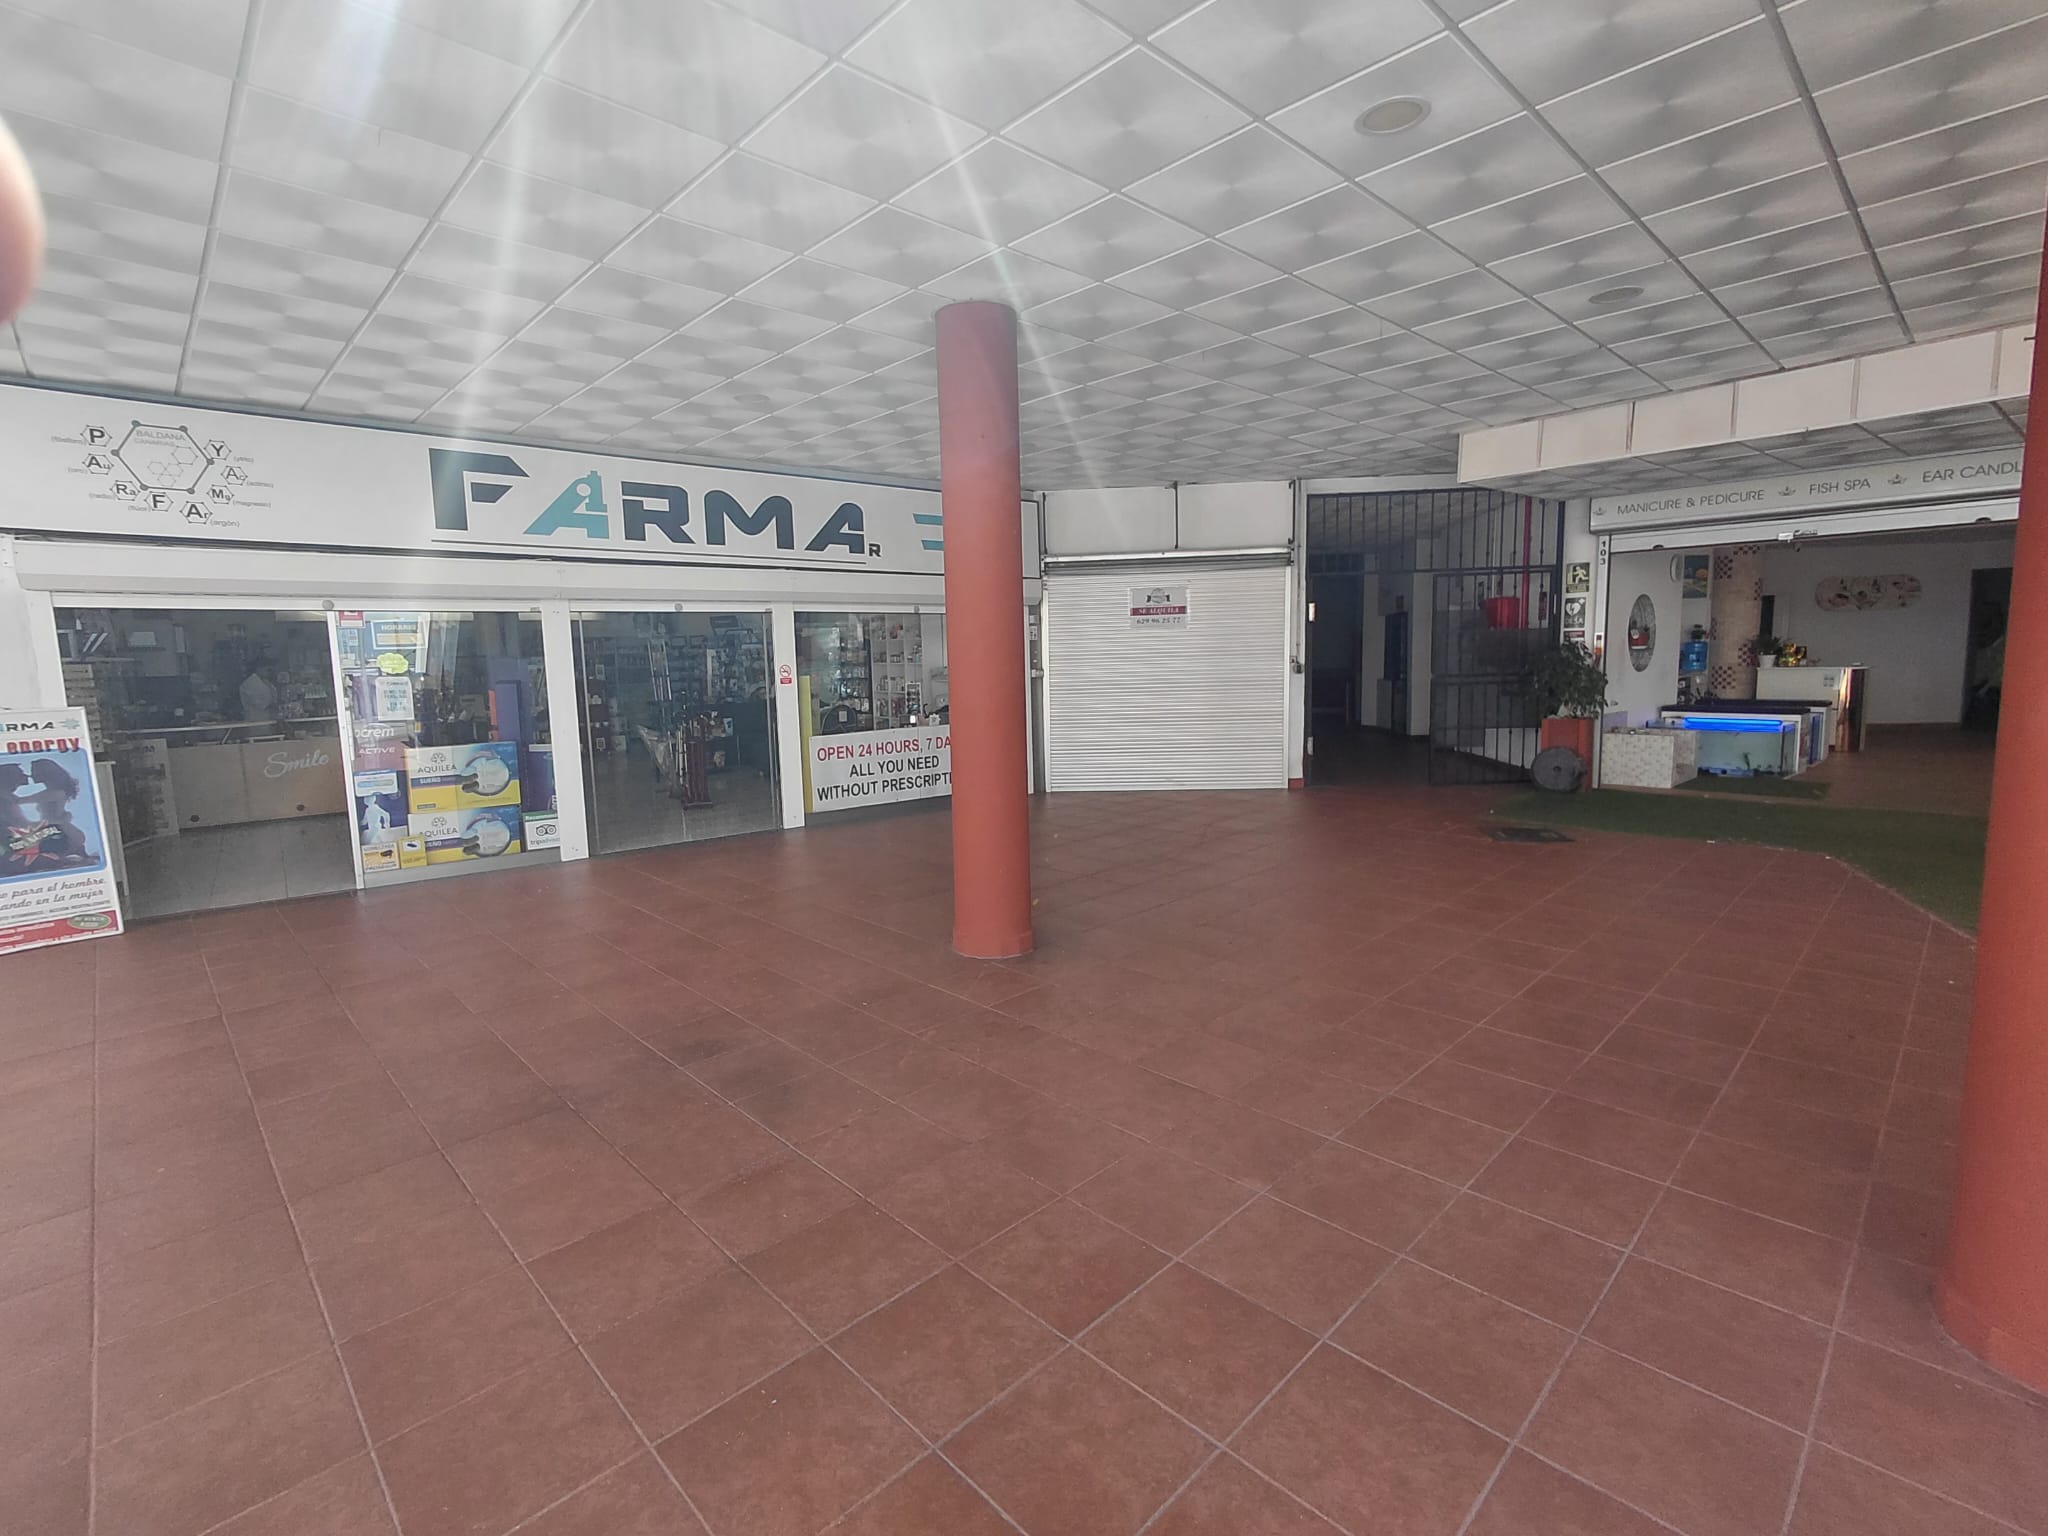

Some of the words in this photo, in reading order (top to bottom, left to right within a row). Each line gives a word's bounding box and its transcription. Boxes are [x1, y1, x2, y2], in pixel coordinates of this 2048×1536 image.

[89, 428, 105, 443] P
[136, 429, 186, 441] BALDANA
[211, 444, 224, 457] Y
[1617, 498, 1681, 515] MANICURE
[1686, 497, 1695, 508] &
[1700, 489, 1765, 506] PEDICURE
[1809, 482, 1839, 495] FISH
[1844, 478, 1871, 491] SPA
[1922, 468, 1954, 483] EAR
[1960, 461, 2022, 479] CANDL
[152, 494, 165, 508] F
[429, 448, 865, 554] FARMA
[0, 722, 54, 731] RMA
[354, 728, 394, 738] ocrem
[817, 745, 854, 761] OPEN
[858, 744, 872, 757] 24
[876, 739, 923, 756] HOURS,
[926, 738, 933, 750] 7
[936, 736, 951, 749] DA
[264, 750, 329, 778] Smile
[418, 764, 457, 773] AQUILEA
[849, 762, 875, 778] ALL
[878, 759, 904, 774] YOU
[907, 755, 940, 770] NEED
[817, 781, 878, 801] WITHOUT
[882, 772, 952, 792] PRESCRIPTI
[420, 828, 458, 837] QUILEA
[11, 887, 43, 899] para
[47, 882, 58, 892] el
[60, 878, 105, 890] hombre
[0, 898, 32, 910] ando
[35, 896, 49, 905] en
[53, 894, 65, 903] la
[69, 888, 104, 901] mujer
